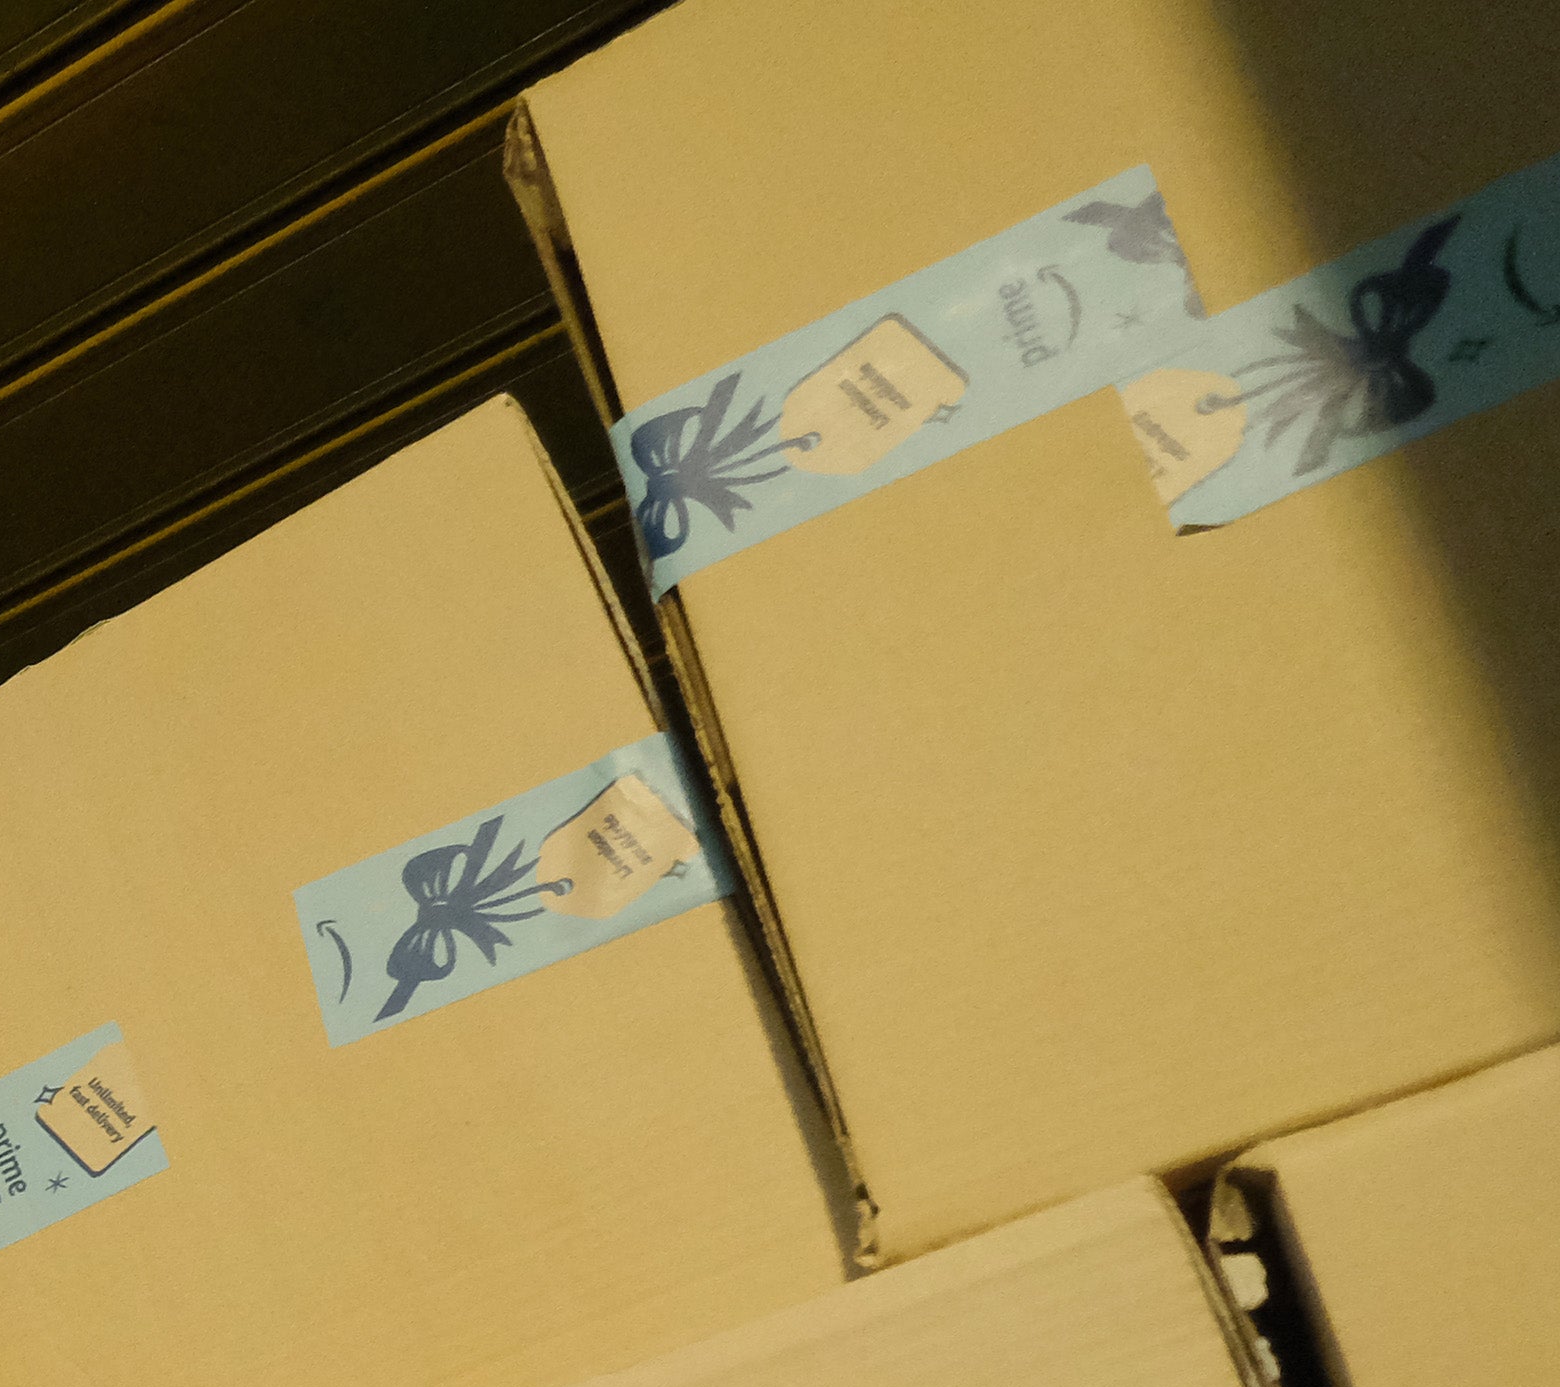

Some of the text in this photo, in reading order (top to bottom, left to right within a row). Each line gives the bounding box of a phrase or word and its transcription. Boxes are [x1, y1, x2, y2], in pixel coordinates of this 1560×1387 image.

[999, 279, 1060, 368] prime
[69, 1085, 124, 1143] fast delivery
[87, 1077, 137, 1128] Unlimited,
